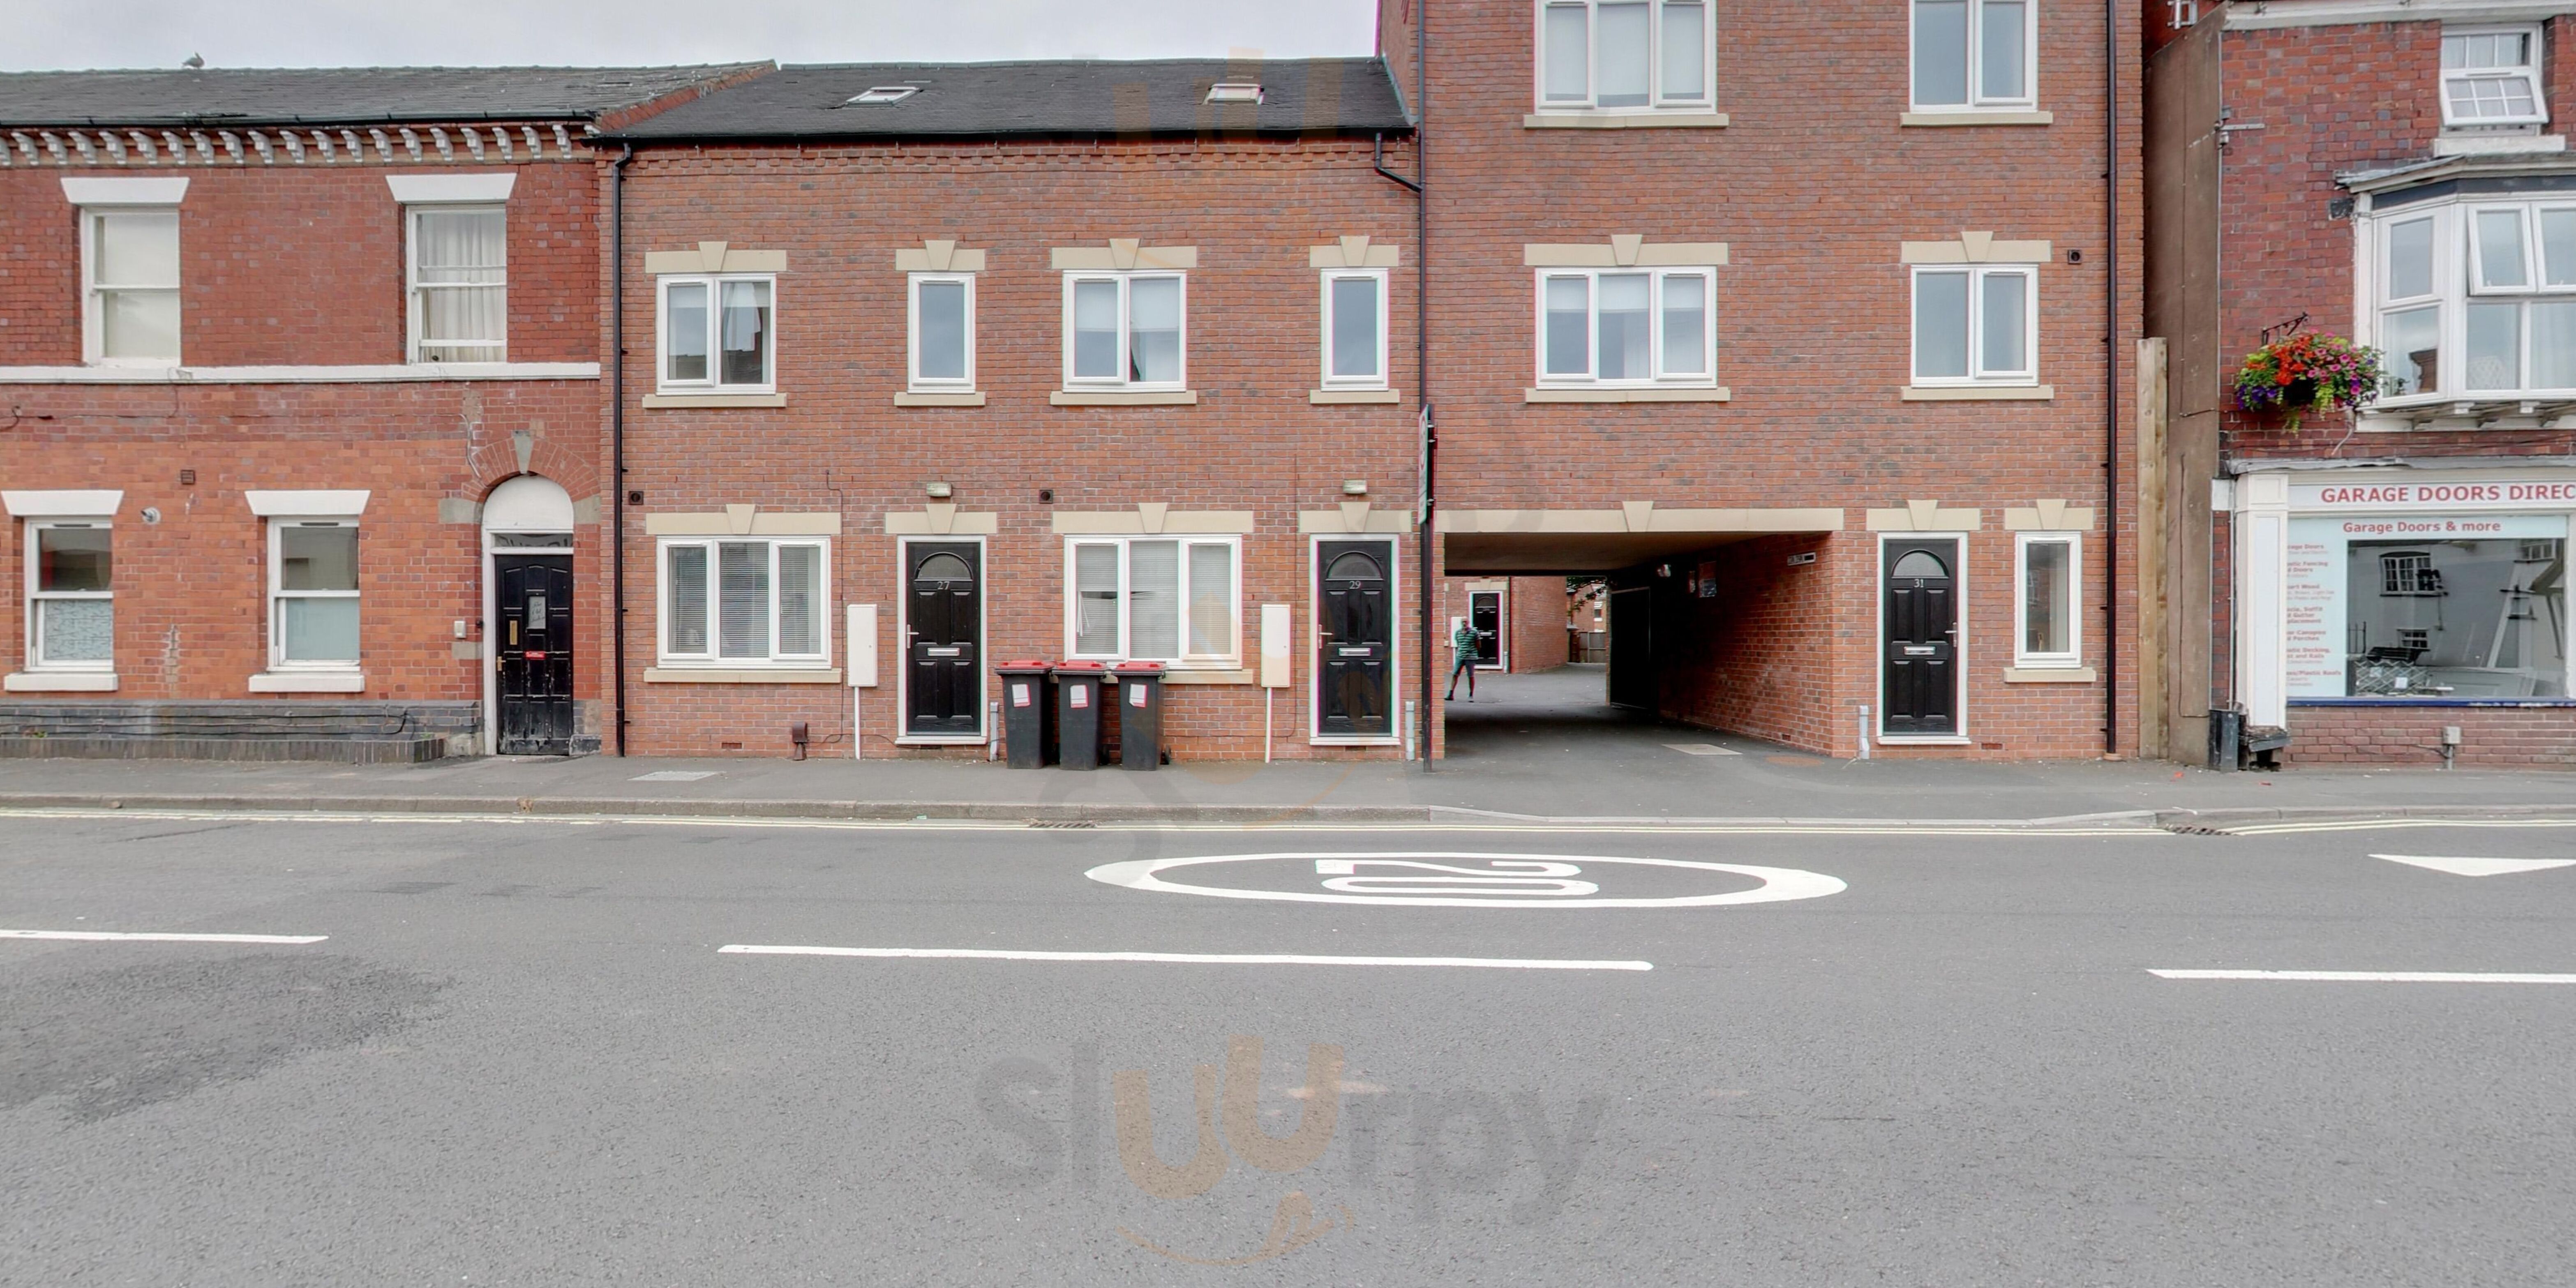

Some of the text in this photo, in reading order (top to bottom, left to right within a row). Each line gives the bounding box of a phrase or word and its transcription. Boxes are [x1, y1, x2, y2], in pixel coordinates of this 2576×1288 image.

[2321, 485, 2576, 503] GARAGE DOORS DIREC
[2343, 521, 2501, 534] Garage Doors & more
[937, 581, 950, 590] 27
[1349, 581, 1361, 589] 29
[1914, 579, 1924, 588] 31
